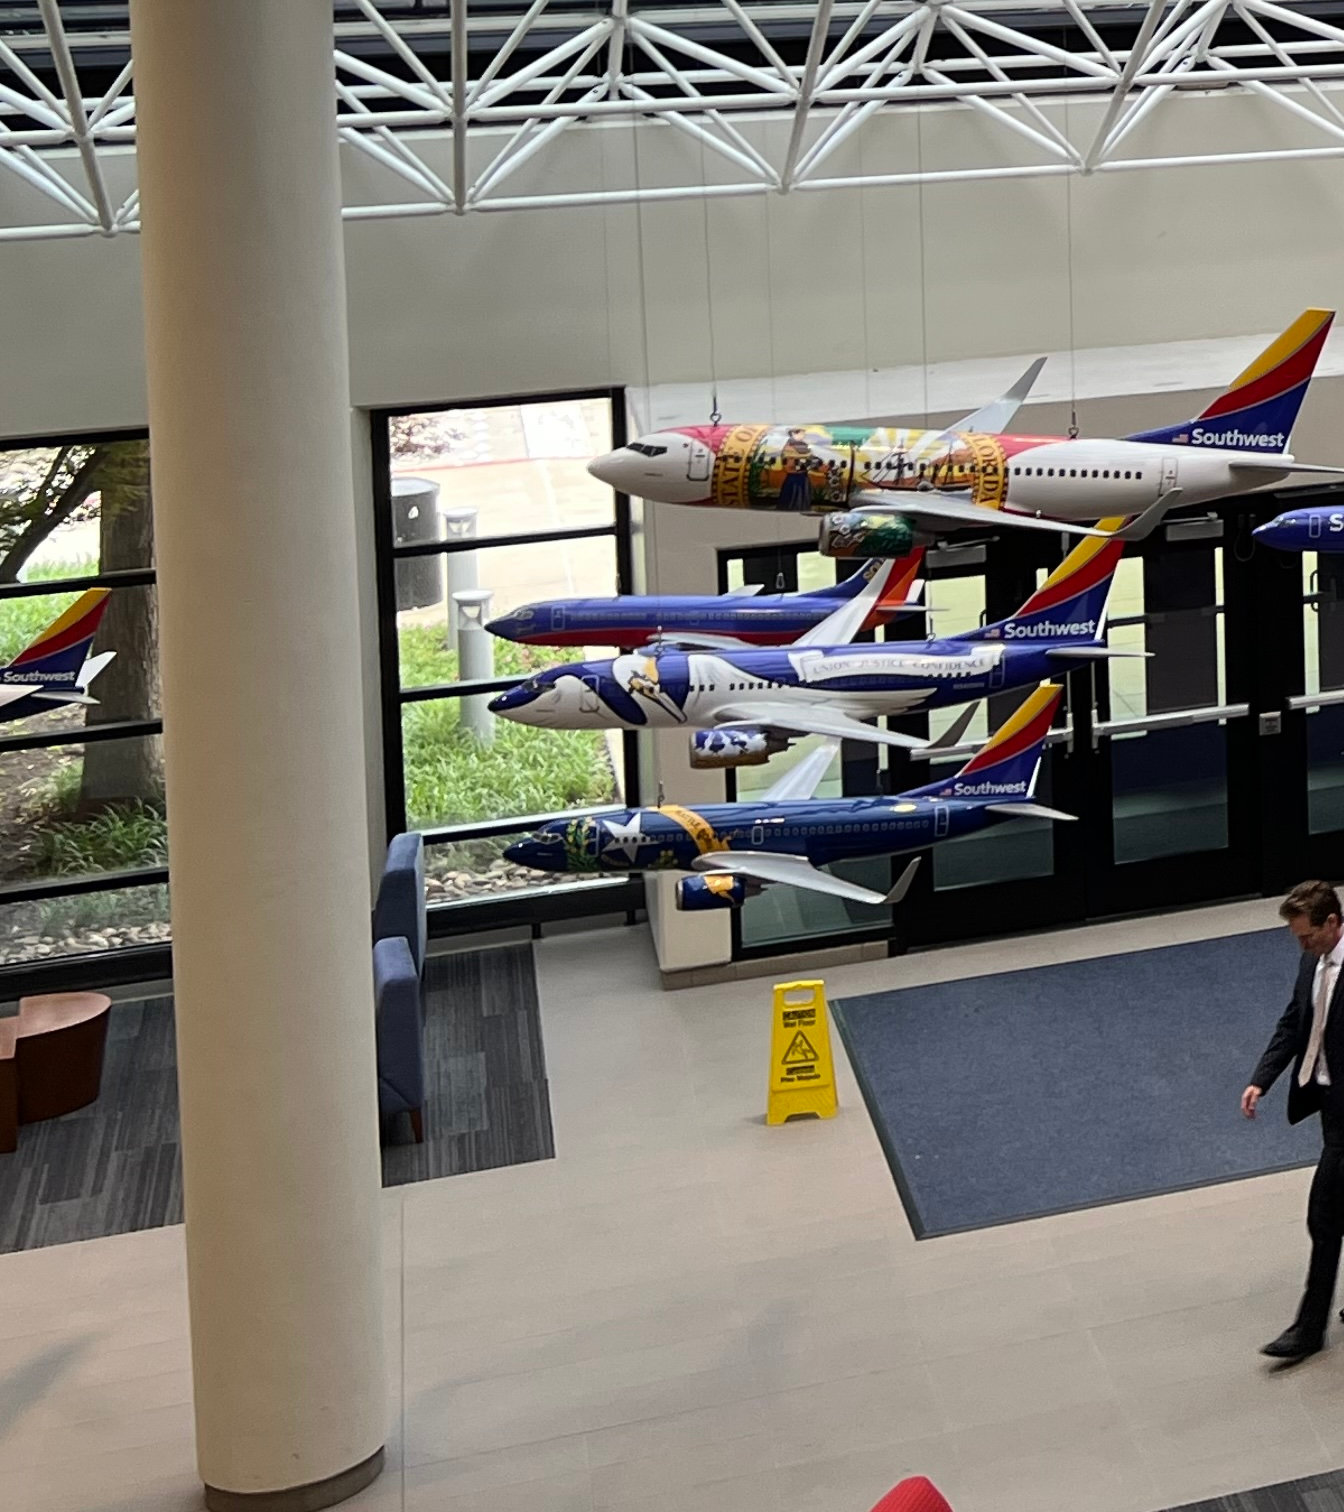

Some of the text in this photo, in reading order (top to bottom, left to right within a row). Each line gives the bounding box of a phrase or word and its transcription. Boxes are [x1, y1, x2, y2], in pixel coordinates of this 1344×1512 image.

[1191, 428, 1285, 448] Southwest
[1004, 618, 1096, 639] Southwest
[3, 670, 76, 683] Southwest
[954, 781, 1027, 796] Southwest
